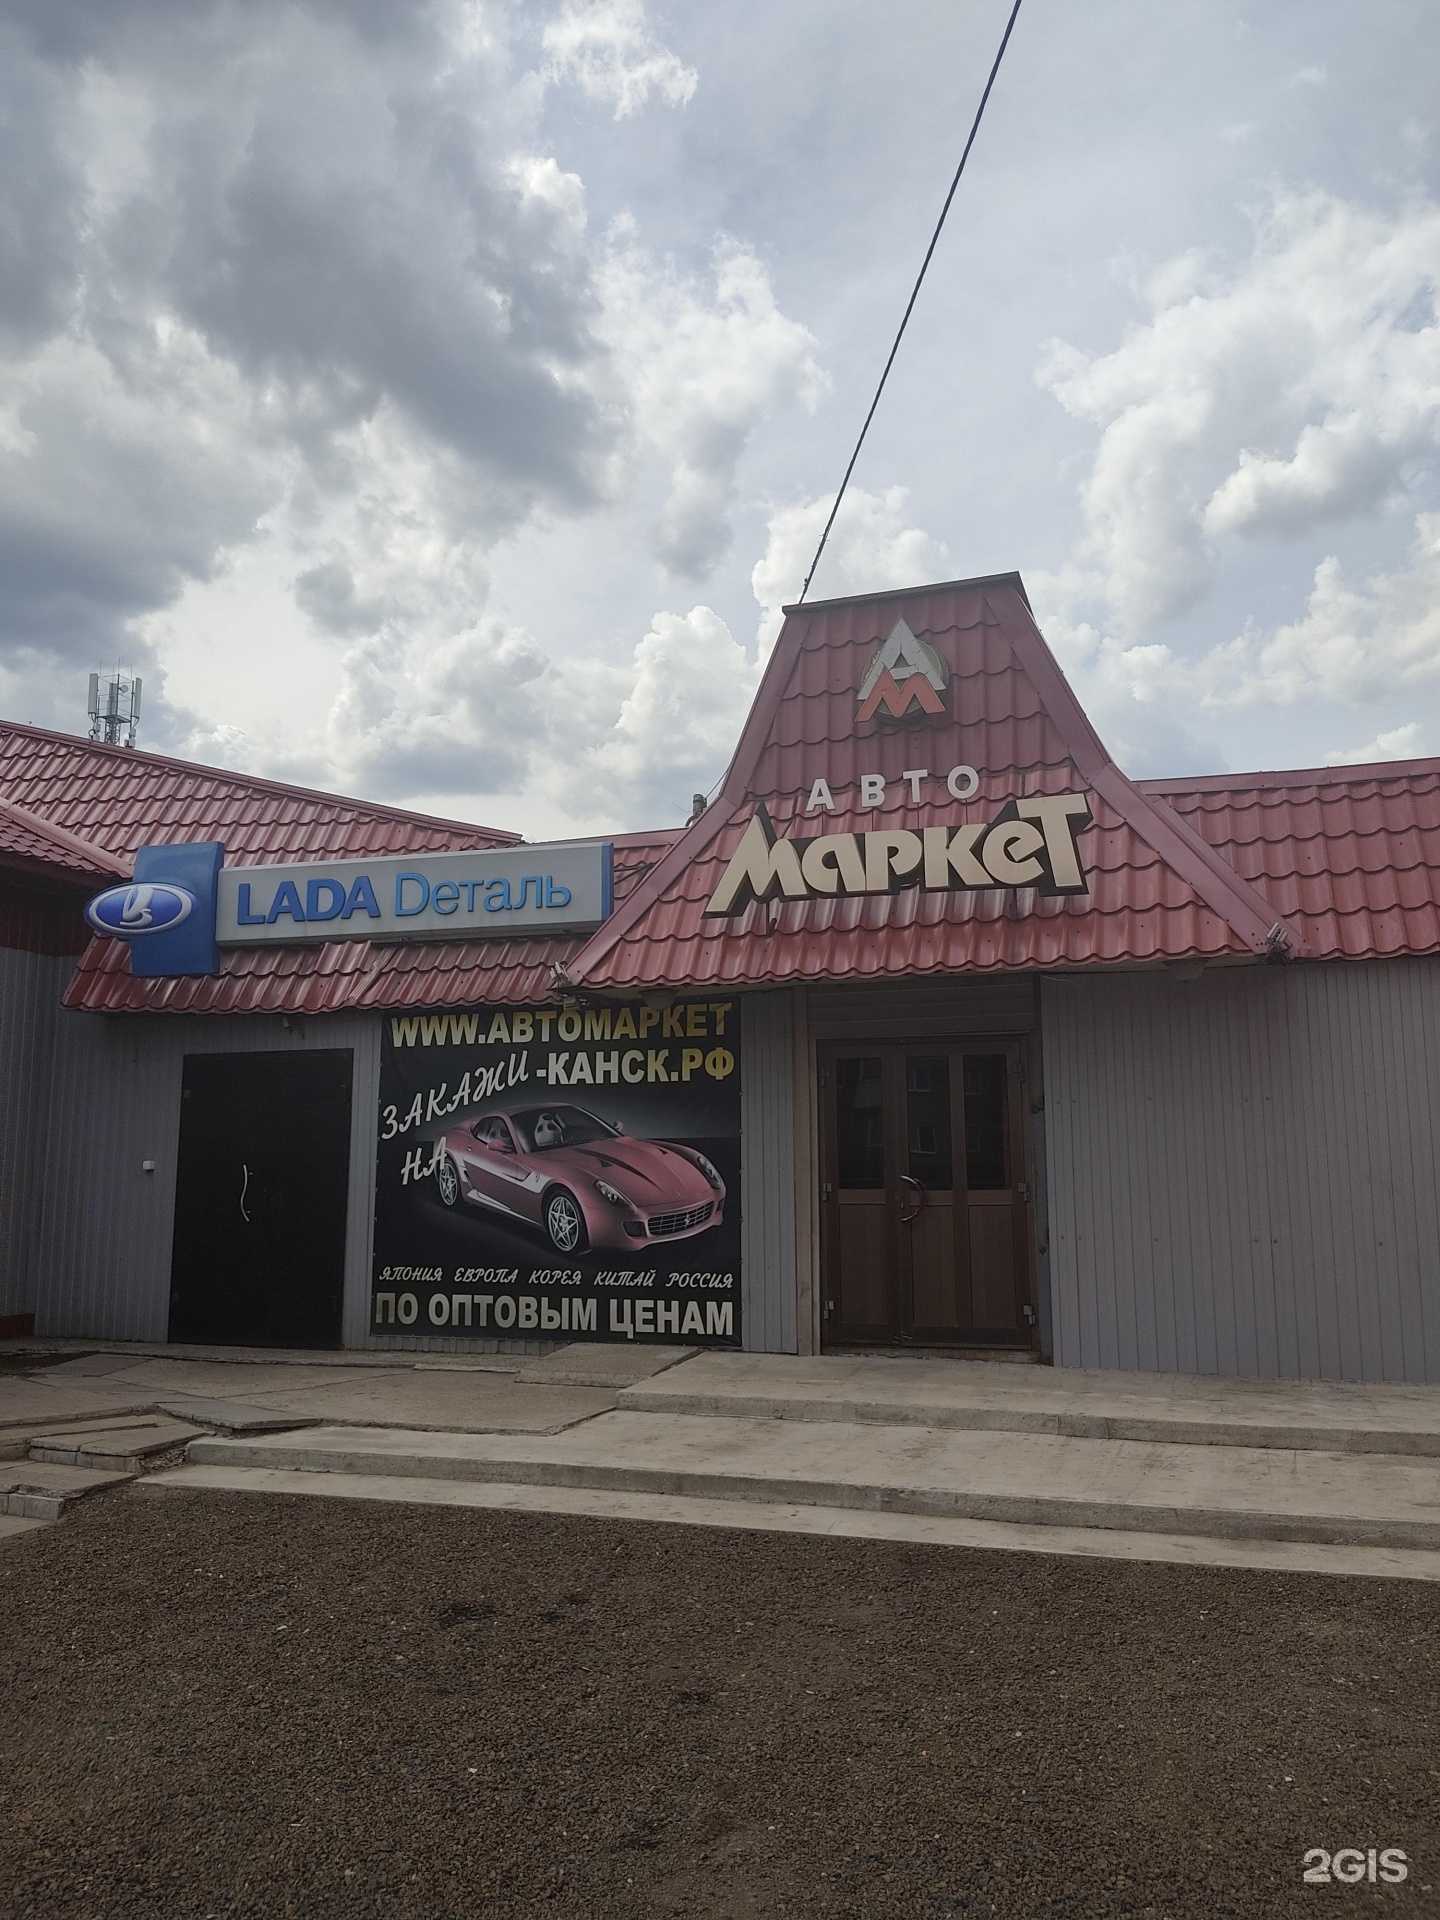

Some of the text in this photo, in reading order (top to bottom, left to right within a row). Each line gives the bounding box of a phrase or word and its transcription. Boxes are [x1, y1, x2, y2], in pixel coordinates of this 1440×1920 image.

[806, 765, 980, 812] АВТО
[236, 875, 381, 925] LADA
[391, 1003, 732, 1047] WWW.АВТОМАРКЕТ
[536, 1048, 734, 1085] -КАНСК.РФ
[381, 1051, 528, 1139] ЗАКАЖИ
[401, 1137, 448, 1185] НА
[379, 1266, 734, 1288] ЯПОНИЯ ЕВРОПА КОРЕЯ КИТАЙ РОССИЯ
[375, 1293, 733, 1339] ПО ОПТОВЫМ ЦЕНАМ
